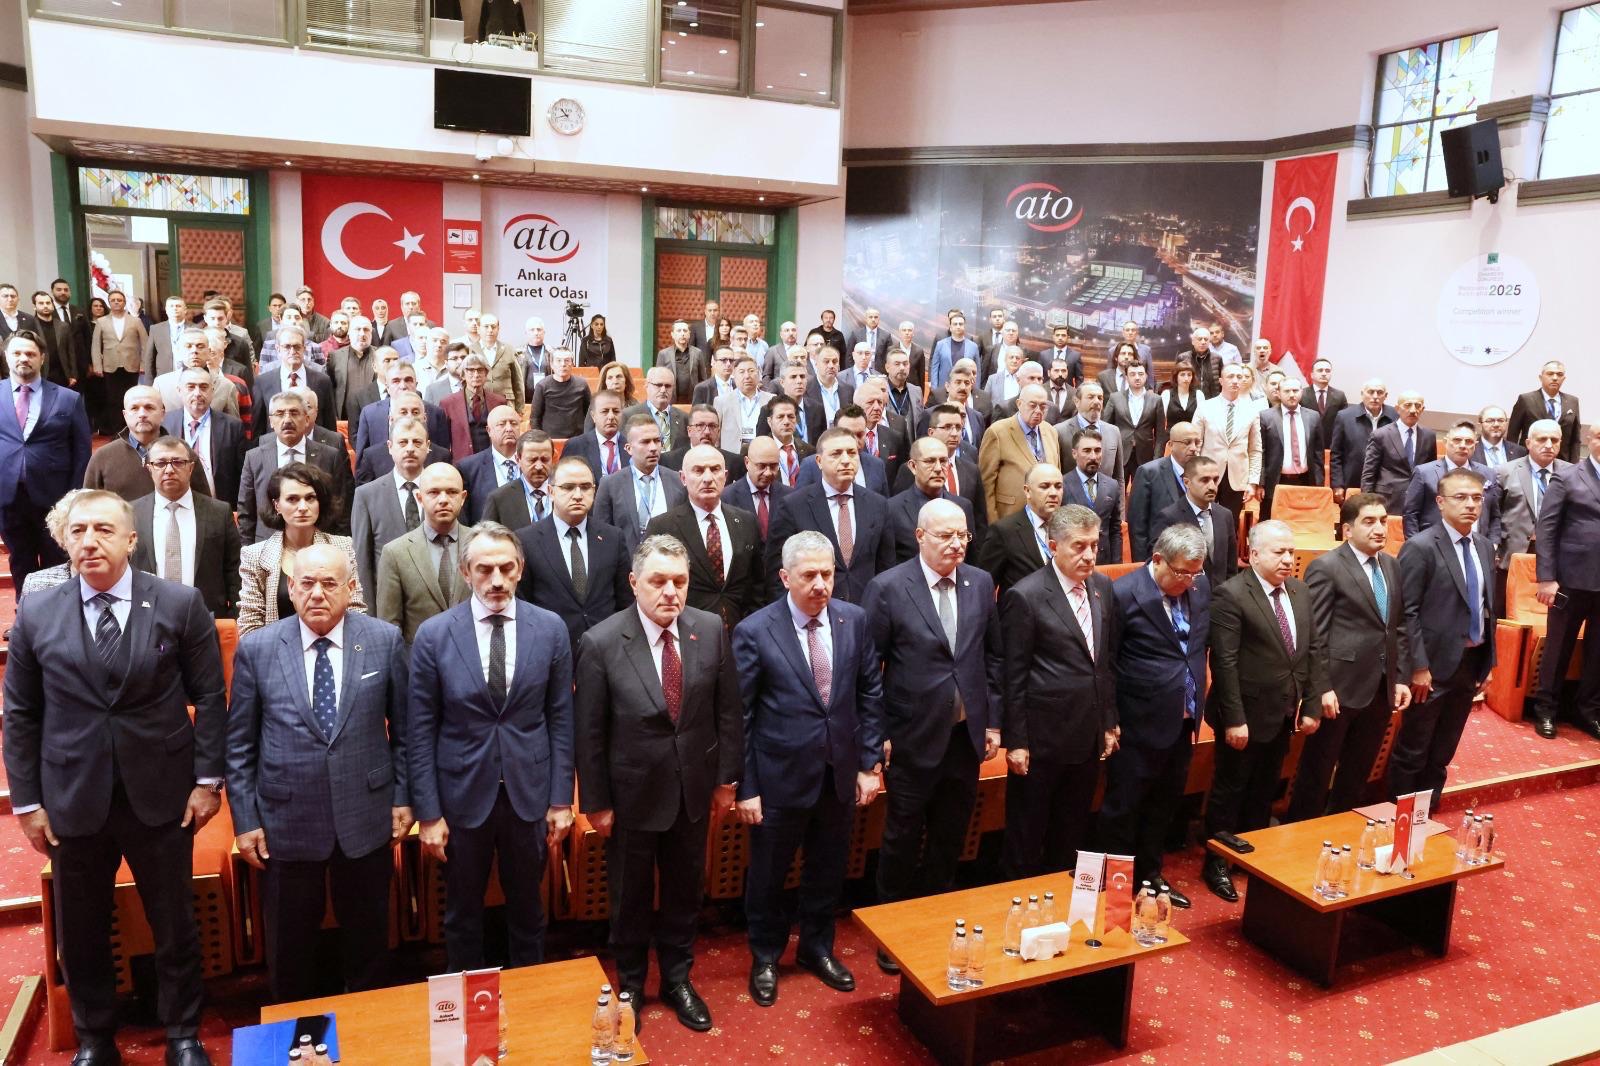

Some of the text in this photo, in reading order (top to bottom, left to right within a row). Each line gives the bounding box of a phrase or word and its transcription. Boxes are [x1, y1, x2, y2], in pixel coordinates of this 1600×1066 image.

[1015, 191, 1073, 220] ato
[513, 223, 570, 251] ato
[517, 268, 567, 282] Ankara
[495, 284, 588, 299] Ticaret Odası
[1489, 284, 1522, 296] 2025
